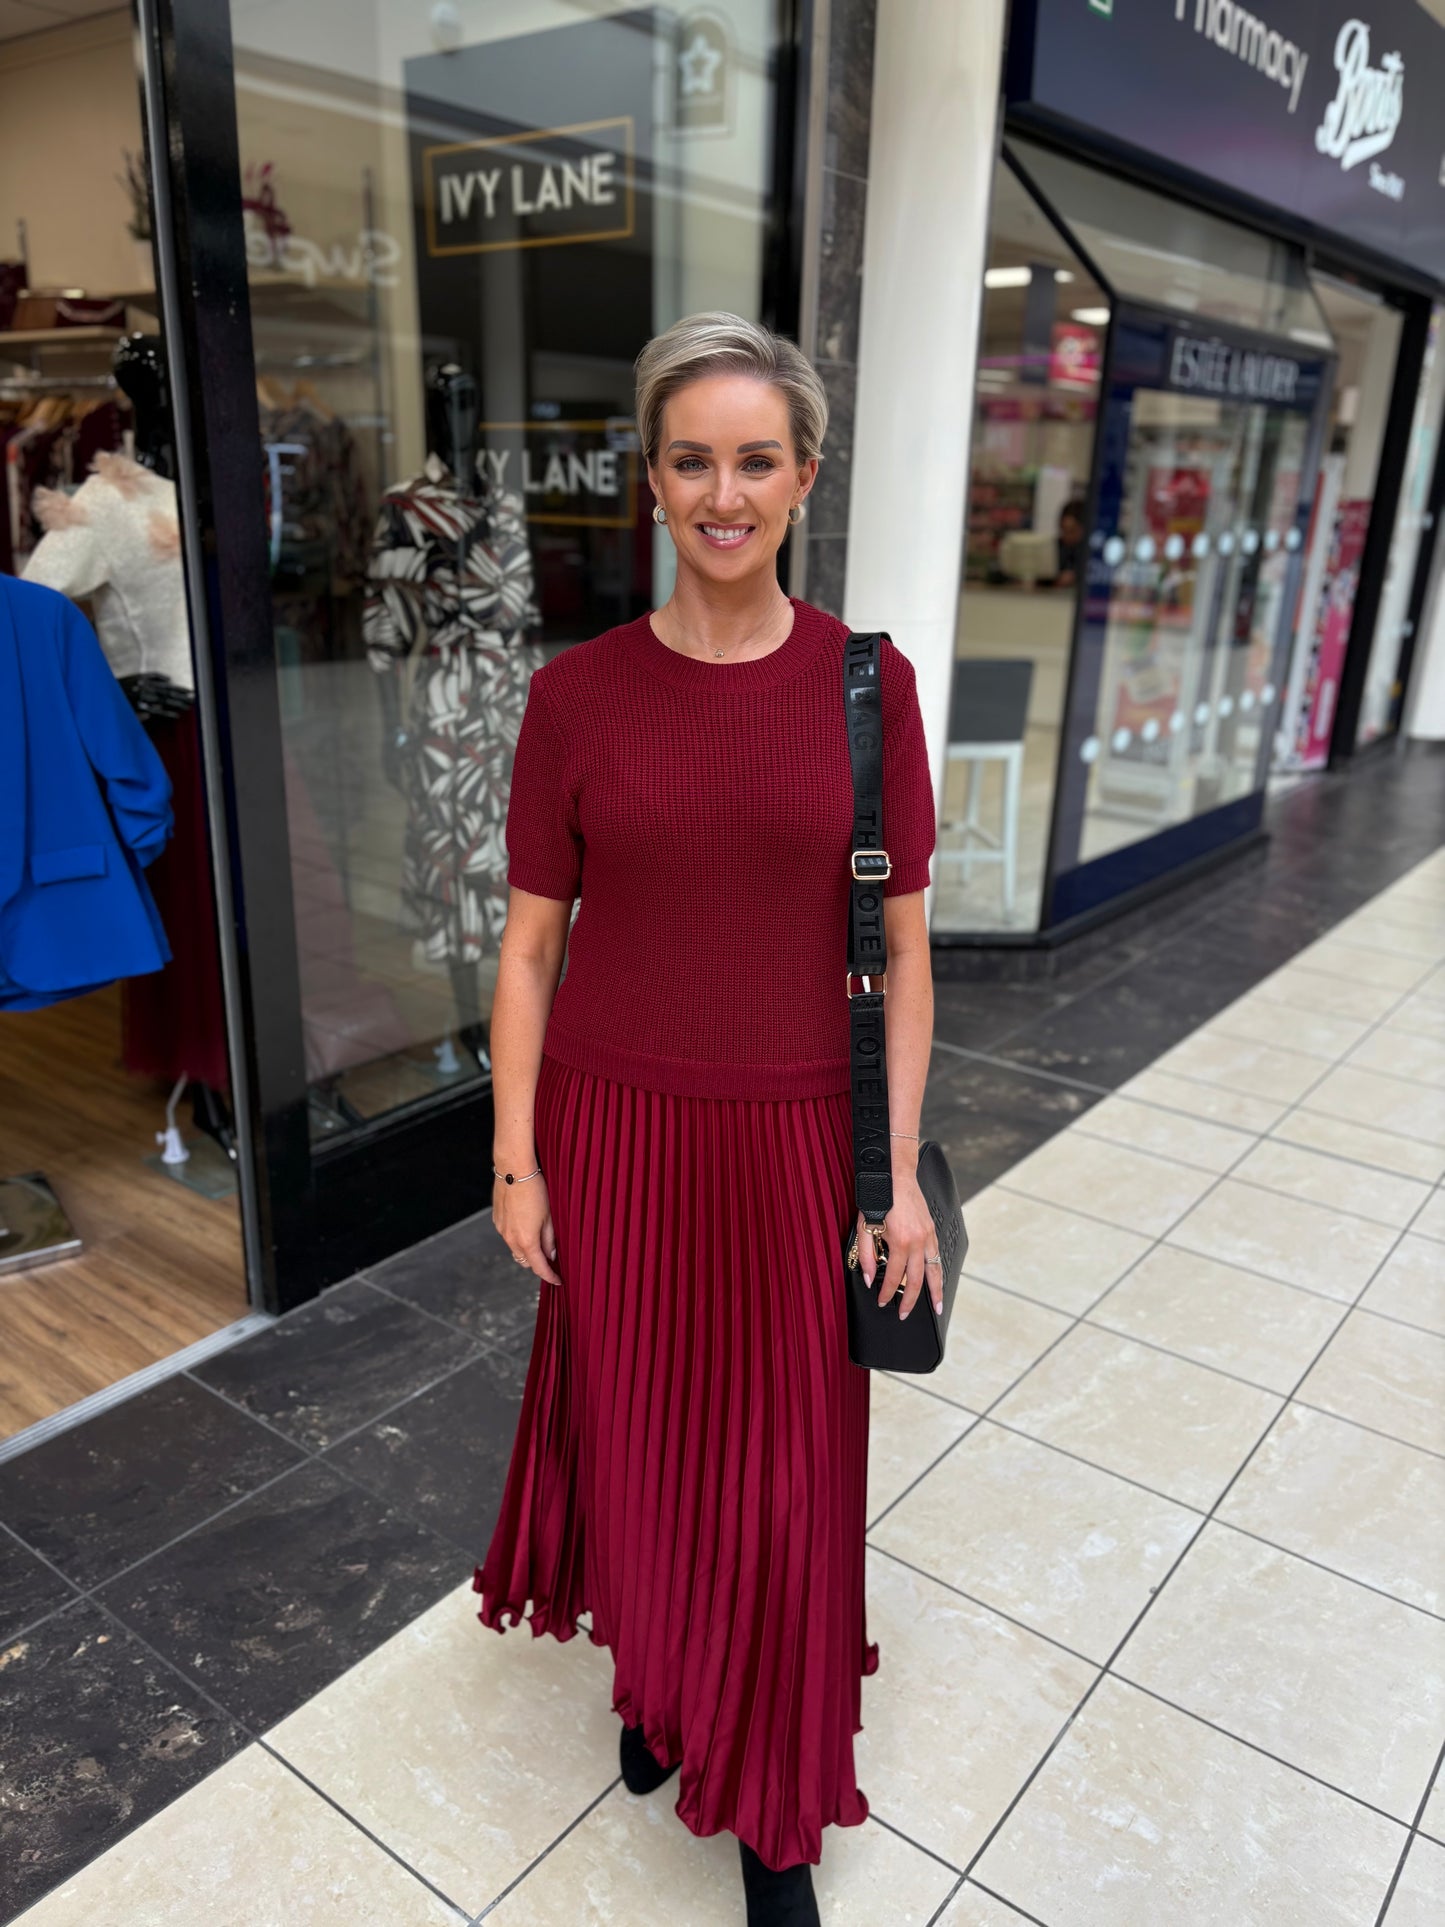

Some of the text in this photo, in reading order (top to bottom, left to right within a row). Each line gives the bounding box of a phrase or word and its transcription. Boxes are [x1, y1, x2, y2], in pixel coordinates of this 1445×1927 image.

[1174, 0, 1309, 114] harmacy
[439, 152, 616, 224] IVY LANE
[521, 449, 619, 497] LANE
[858, 887, 882, 952] OTE
[857, 1016, 887, 1167] TOTE BAG
